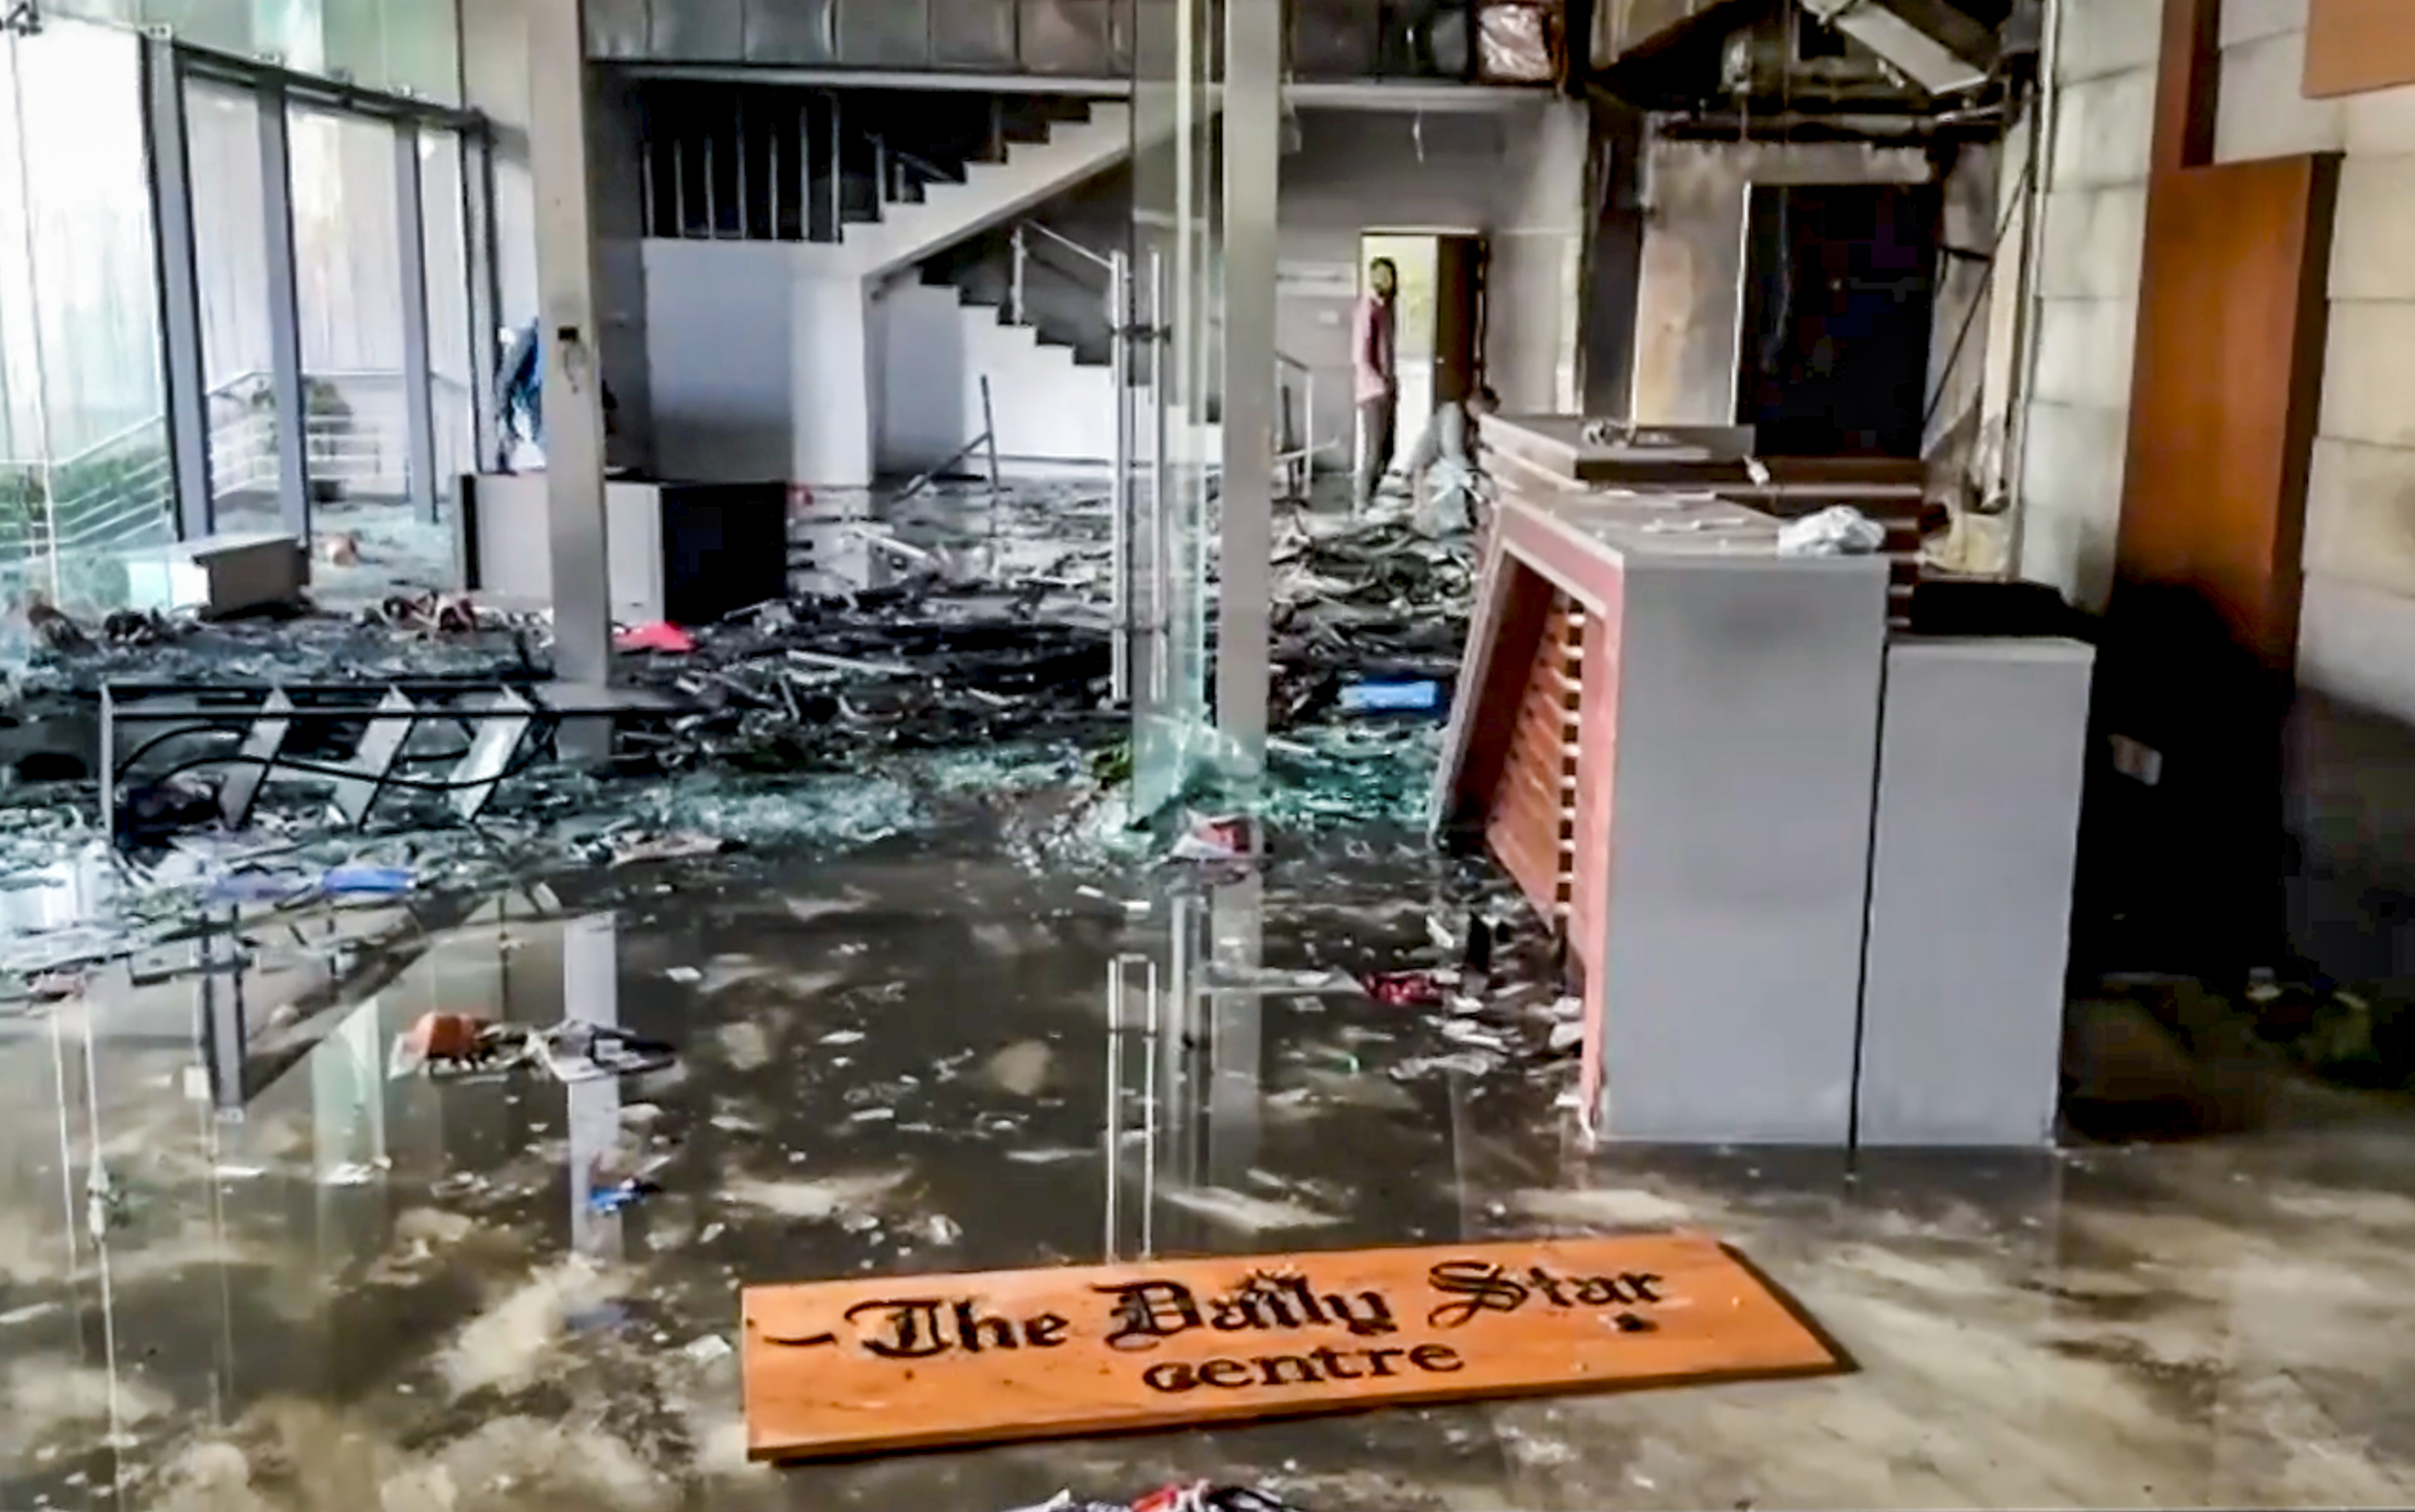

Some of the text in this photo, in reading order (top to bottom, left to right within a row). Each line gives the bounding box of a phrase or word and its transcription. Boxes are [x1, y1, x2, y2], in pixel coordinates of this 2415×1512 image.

[844, 1260, 1664, 1358] The Daily Star
[1142, 1342, 1465, 1392] centre
